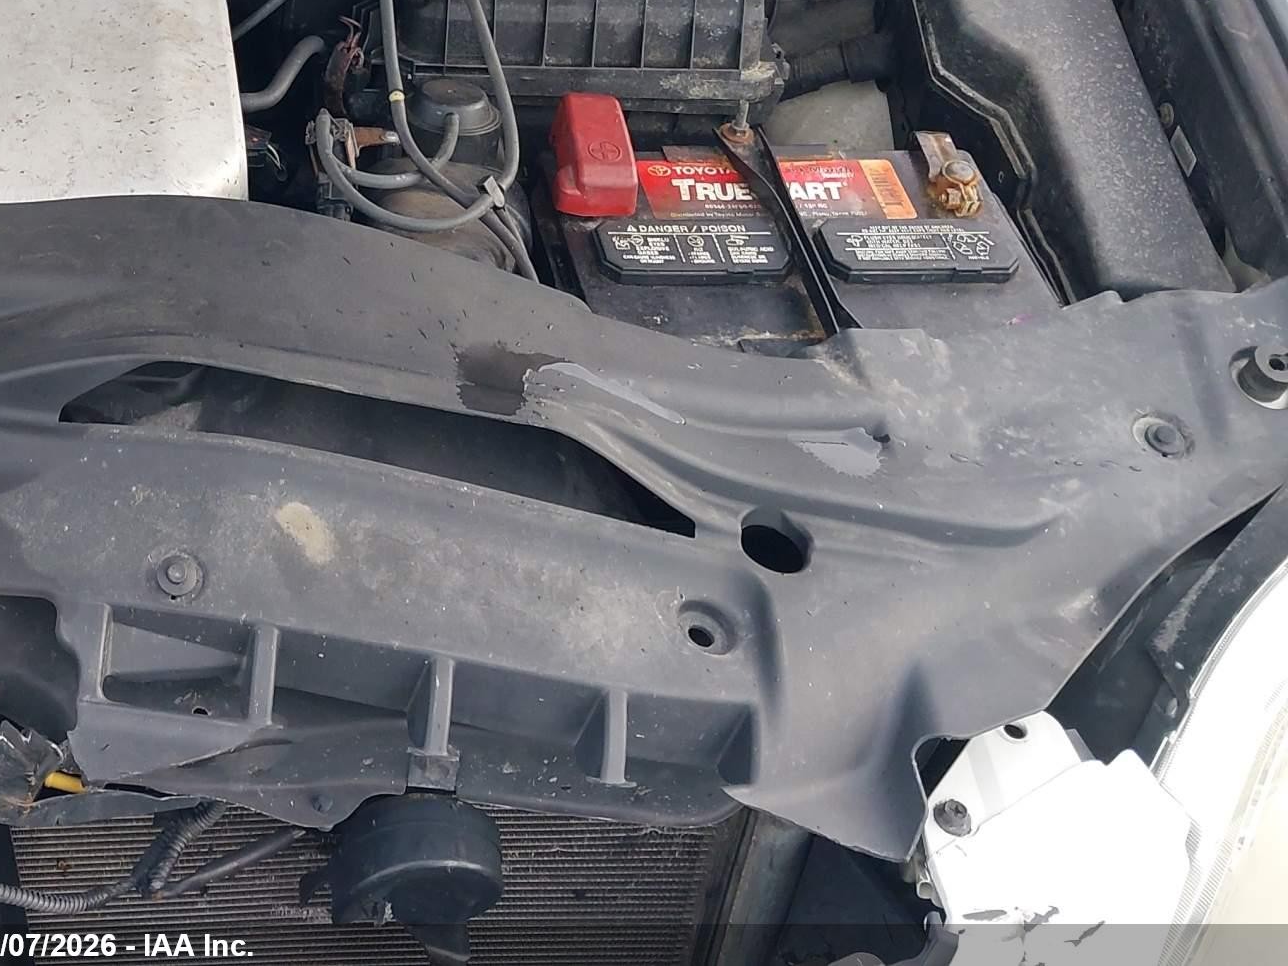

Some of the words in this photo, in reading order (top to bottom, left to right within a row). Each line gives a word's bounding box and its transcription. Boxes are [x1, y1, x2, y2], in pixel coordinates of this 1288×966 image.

[671, 178, 842, 201] TRUEART
[638, 224, 689, 233] DANGER
[701, 224, 746, 233] POISON
